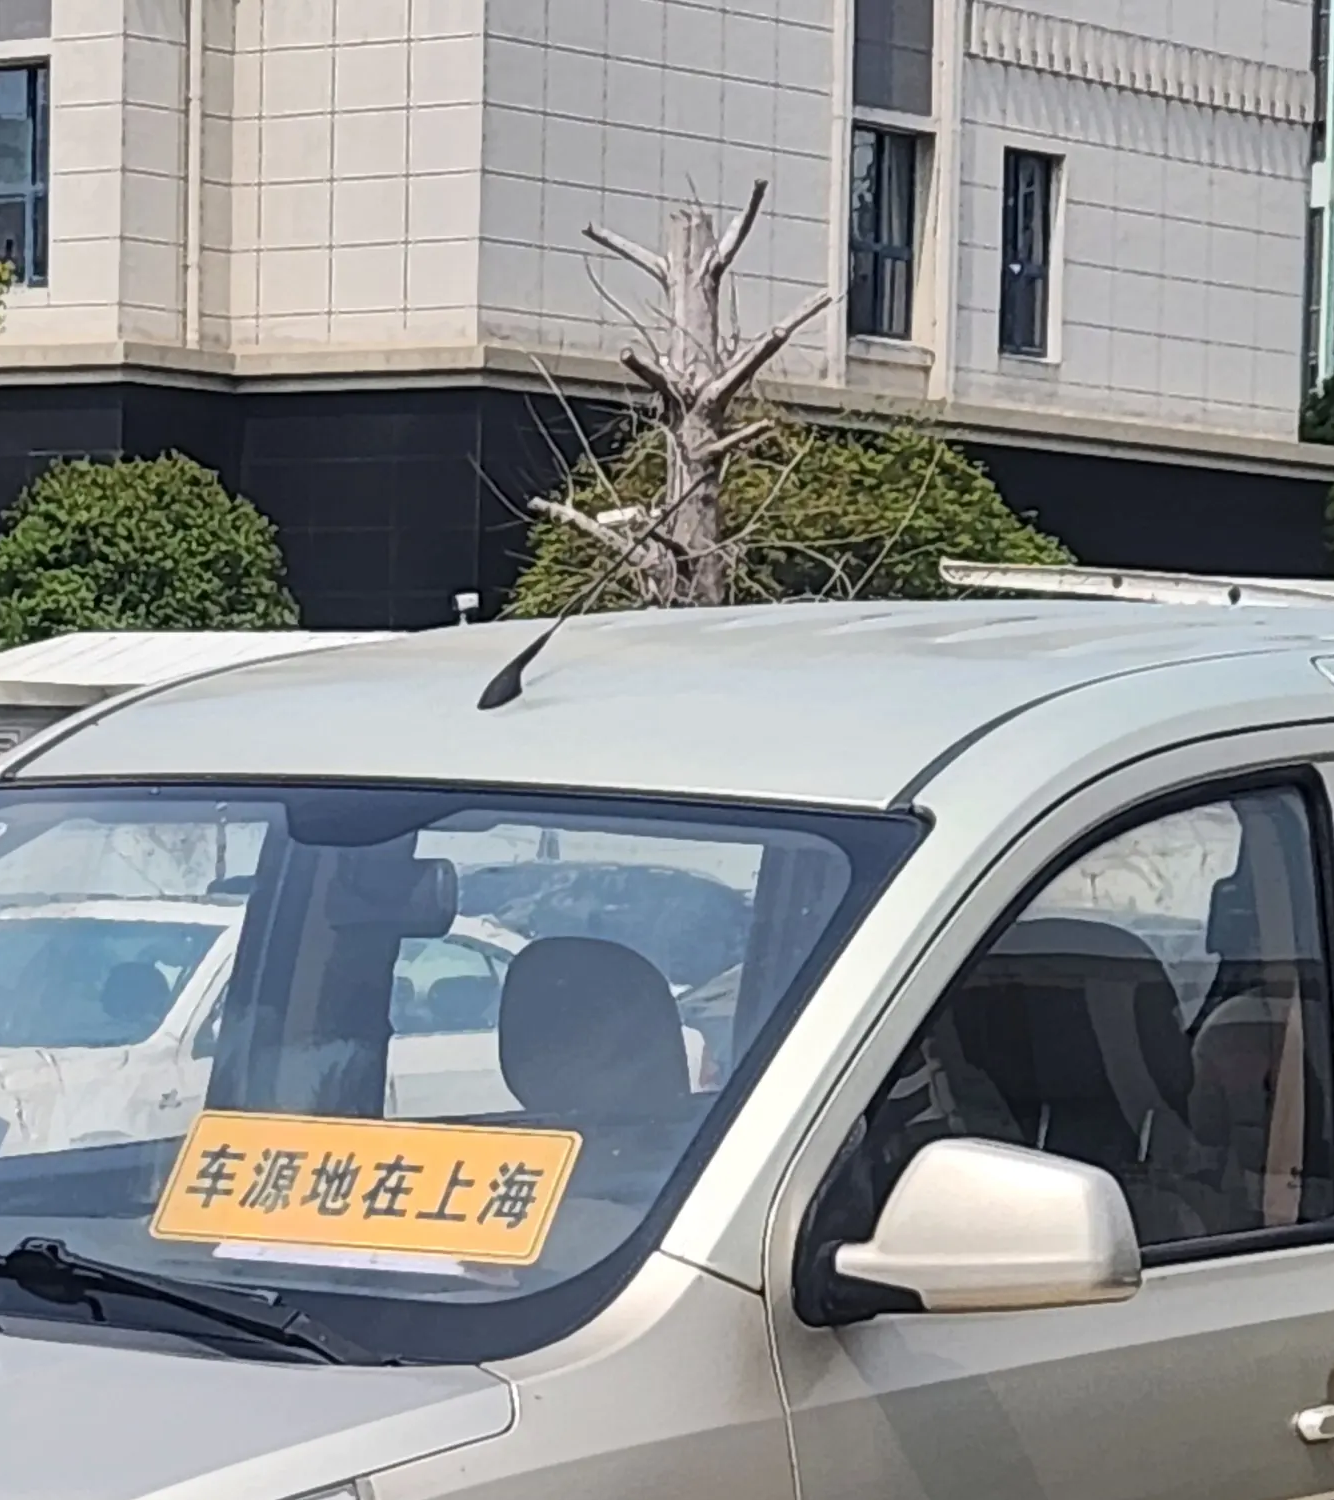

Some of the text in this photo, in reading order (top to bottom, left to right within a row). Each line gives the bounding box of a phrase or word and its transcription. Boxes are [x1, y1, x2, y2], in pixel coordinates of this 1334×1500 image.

[185, 1143, 544, 1229] 车源地在上海
